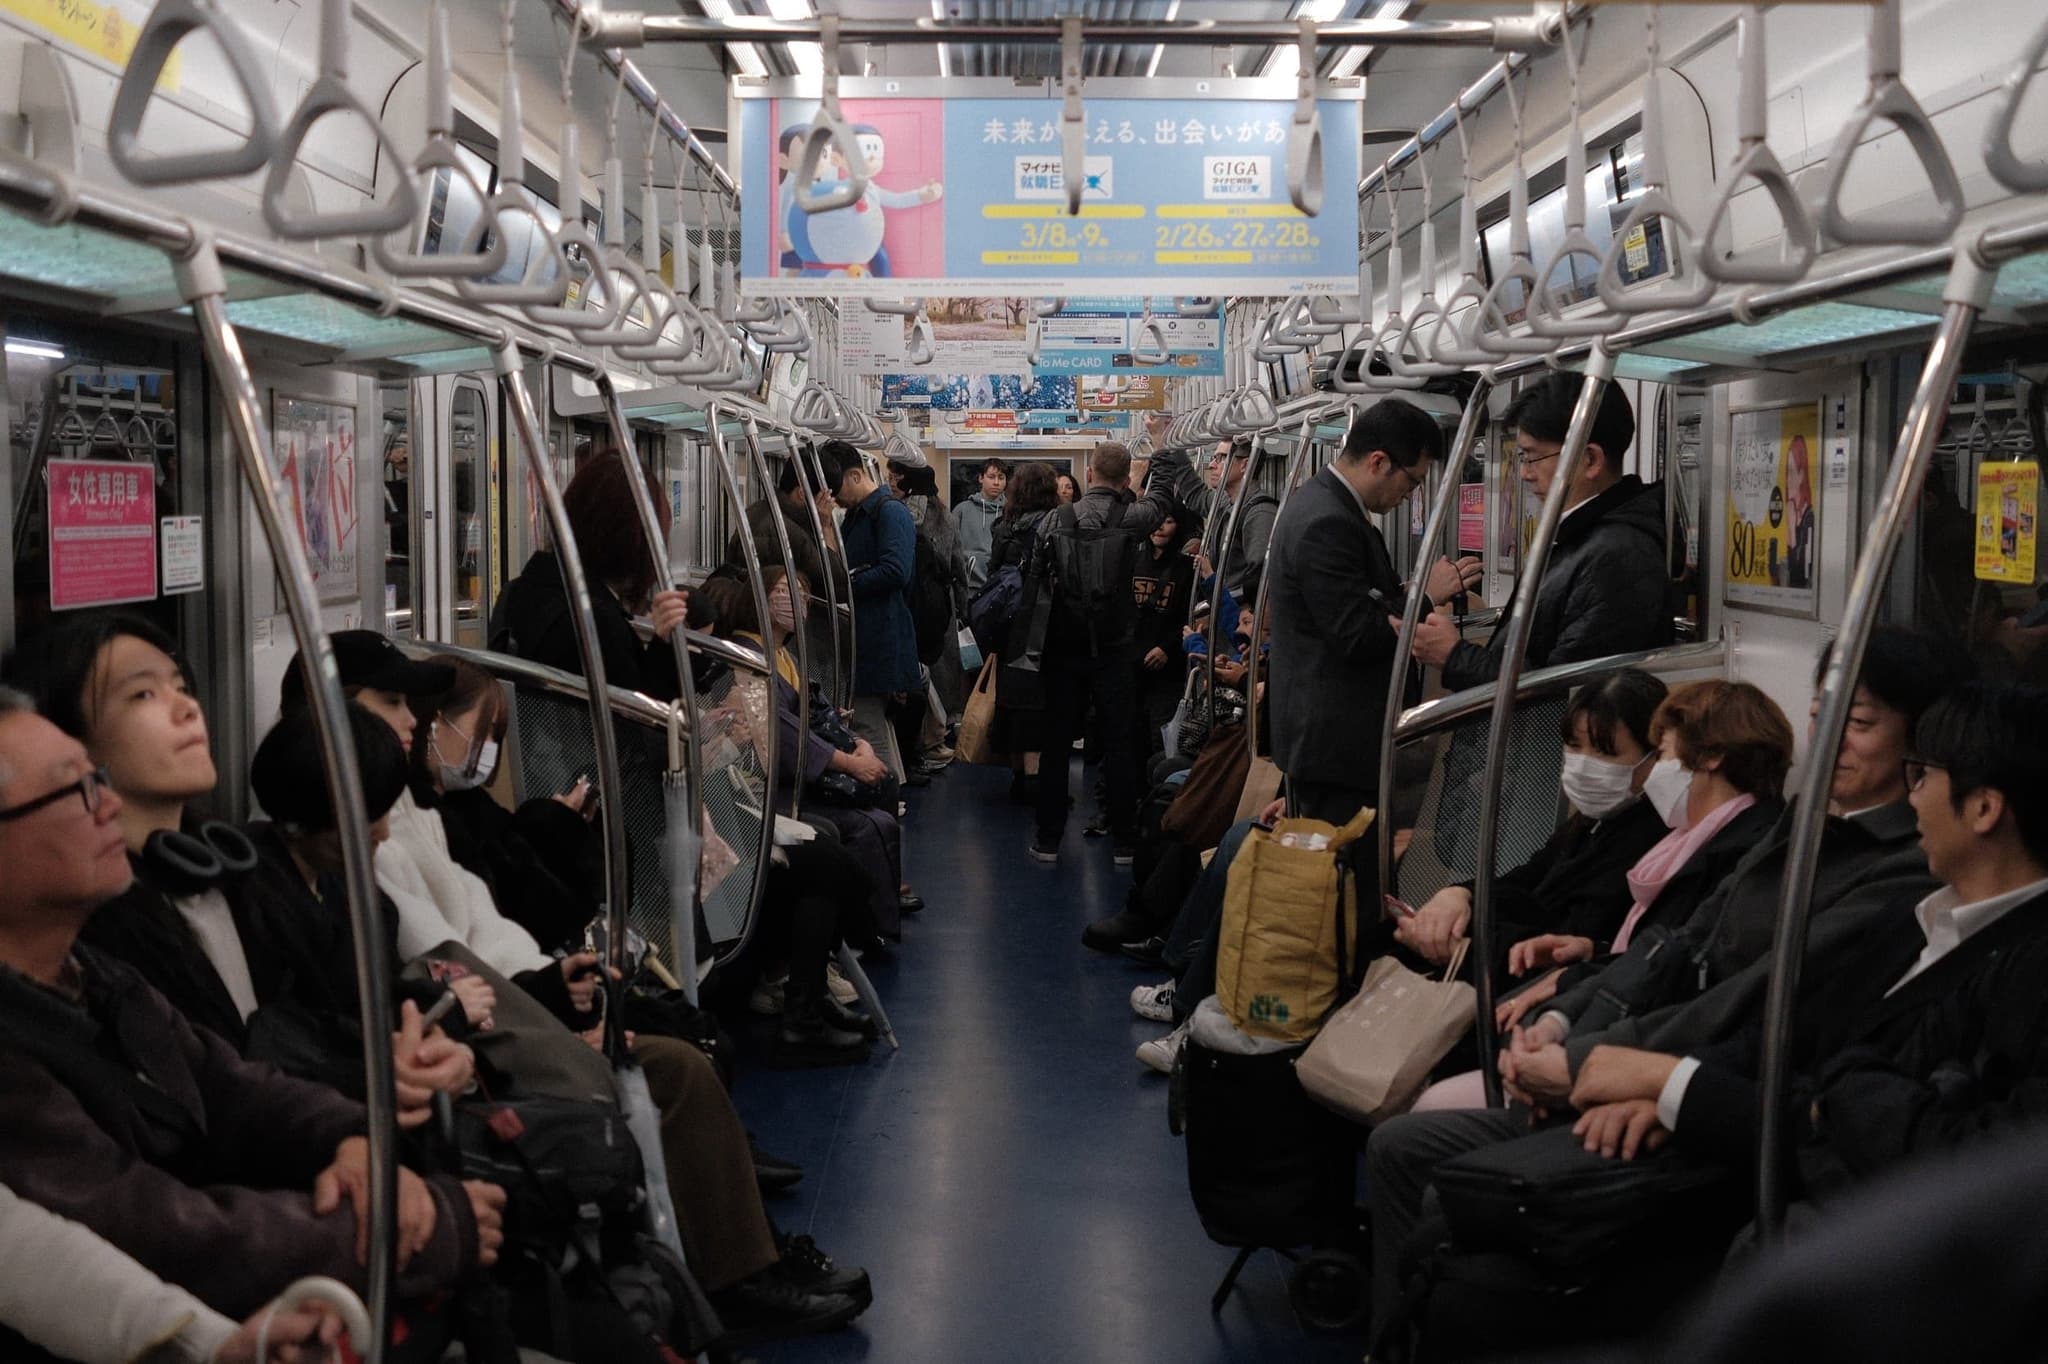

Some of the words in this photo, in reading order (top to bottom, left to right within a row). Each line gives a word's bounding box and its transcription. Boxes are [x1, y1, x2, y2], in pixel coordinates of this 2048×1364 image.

[983, 117, 1286, 146] 未来がえる、出会いがあ
[1020, 162, 1061, 174] マイナビ
[1212, 161, 1258, 176] GIGA
[1052, 357, 1070, 368] Me
[1071, 357, 1102, 368] CARD
[68, 470, 139, 506] 女性専用車
[1731, 521, 1755, 578] 80
